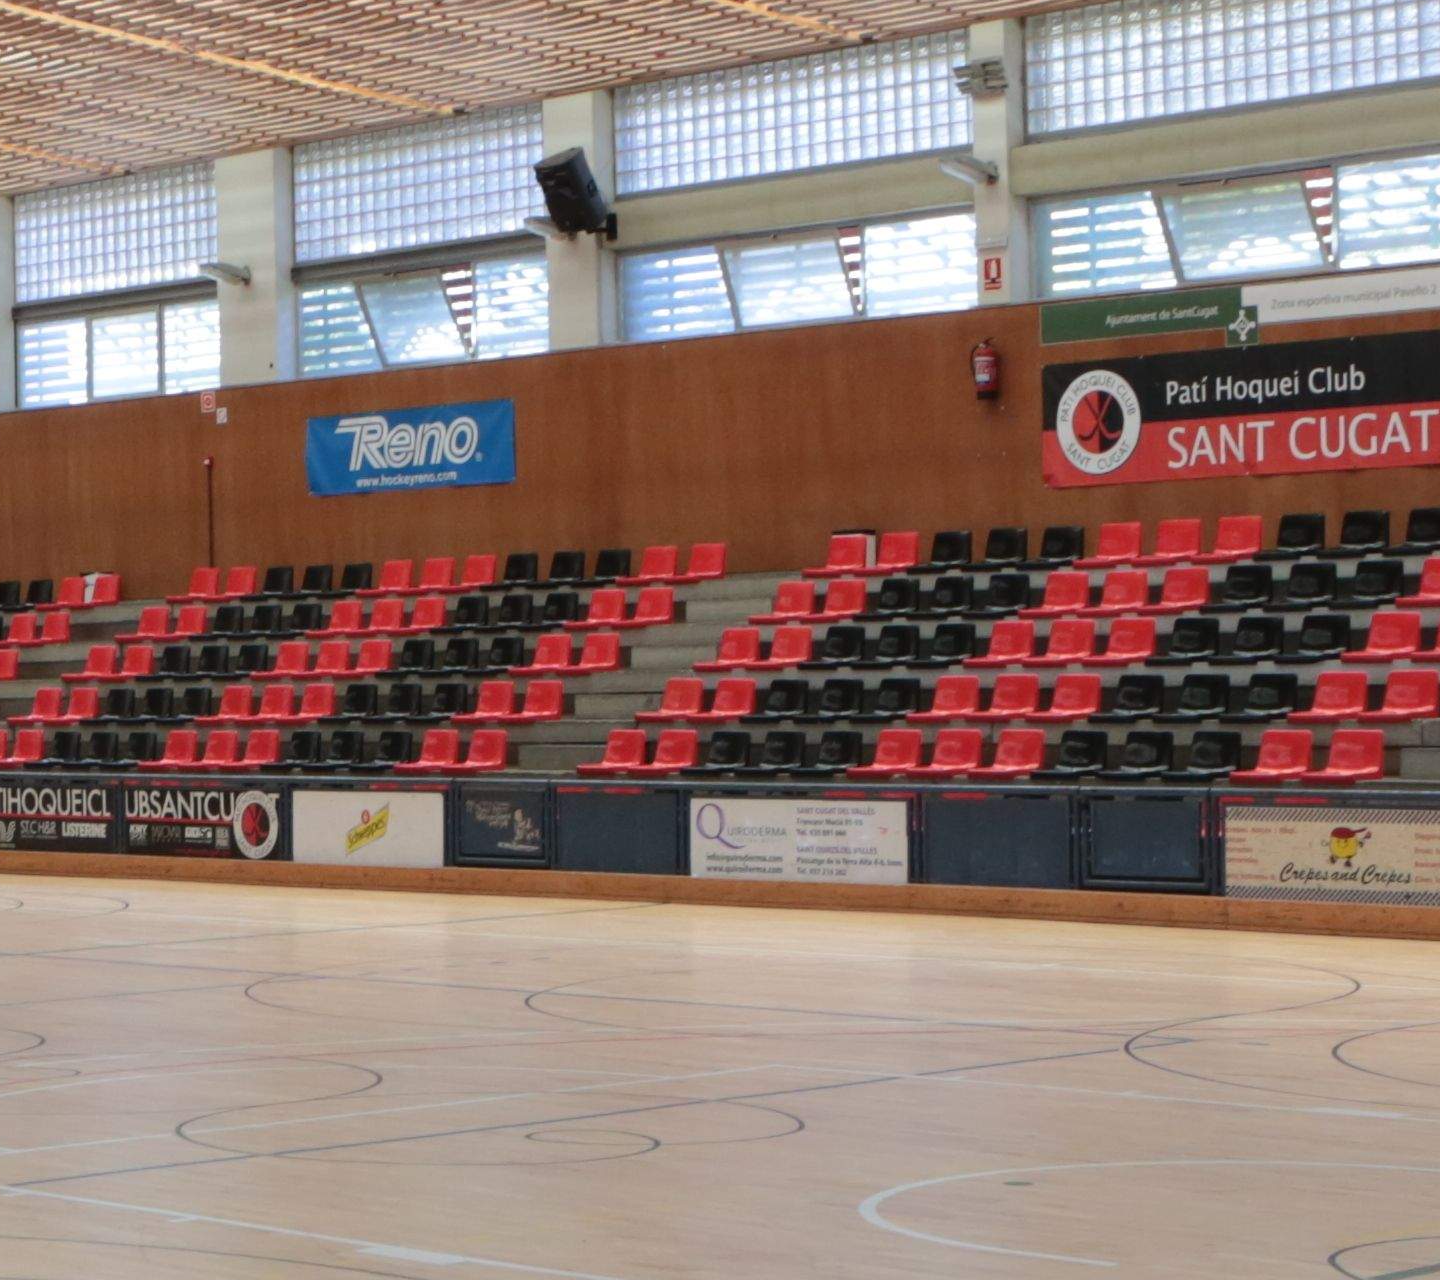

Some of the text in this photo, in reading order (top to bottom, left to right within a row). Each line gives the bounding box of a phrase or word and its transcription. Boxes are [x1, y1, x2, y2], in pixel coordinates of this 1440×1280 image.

[1297, 293, 1341, 309] esportiva
[1344, 288, 1391, 304] municipal
[1431, 283, 1438, 295] 2
[1105, 311, 1157, 328] Ajuntament
[1159, 309, 1170, 320] de
[1166, 364, 1366, 406] Patí Hoquei Club
[335, 415, 478, 471] Reno
[1167, 408, 1440, 469] SANT CUGAT
[355, 471, 457, 488] www.hockeyreno.com
[1280, 862, 1329, 885] Crepes
[1330, 867, 1360, 882] and
[1361, 864, 1412, 885] Crepes
